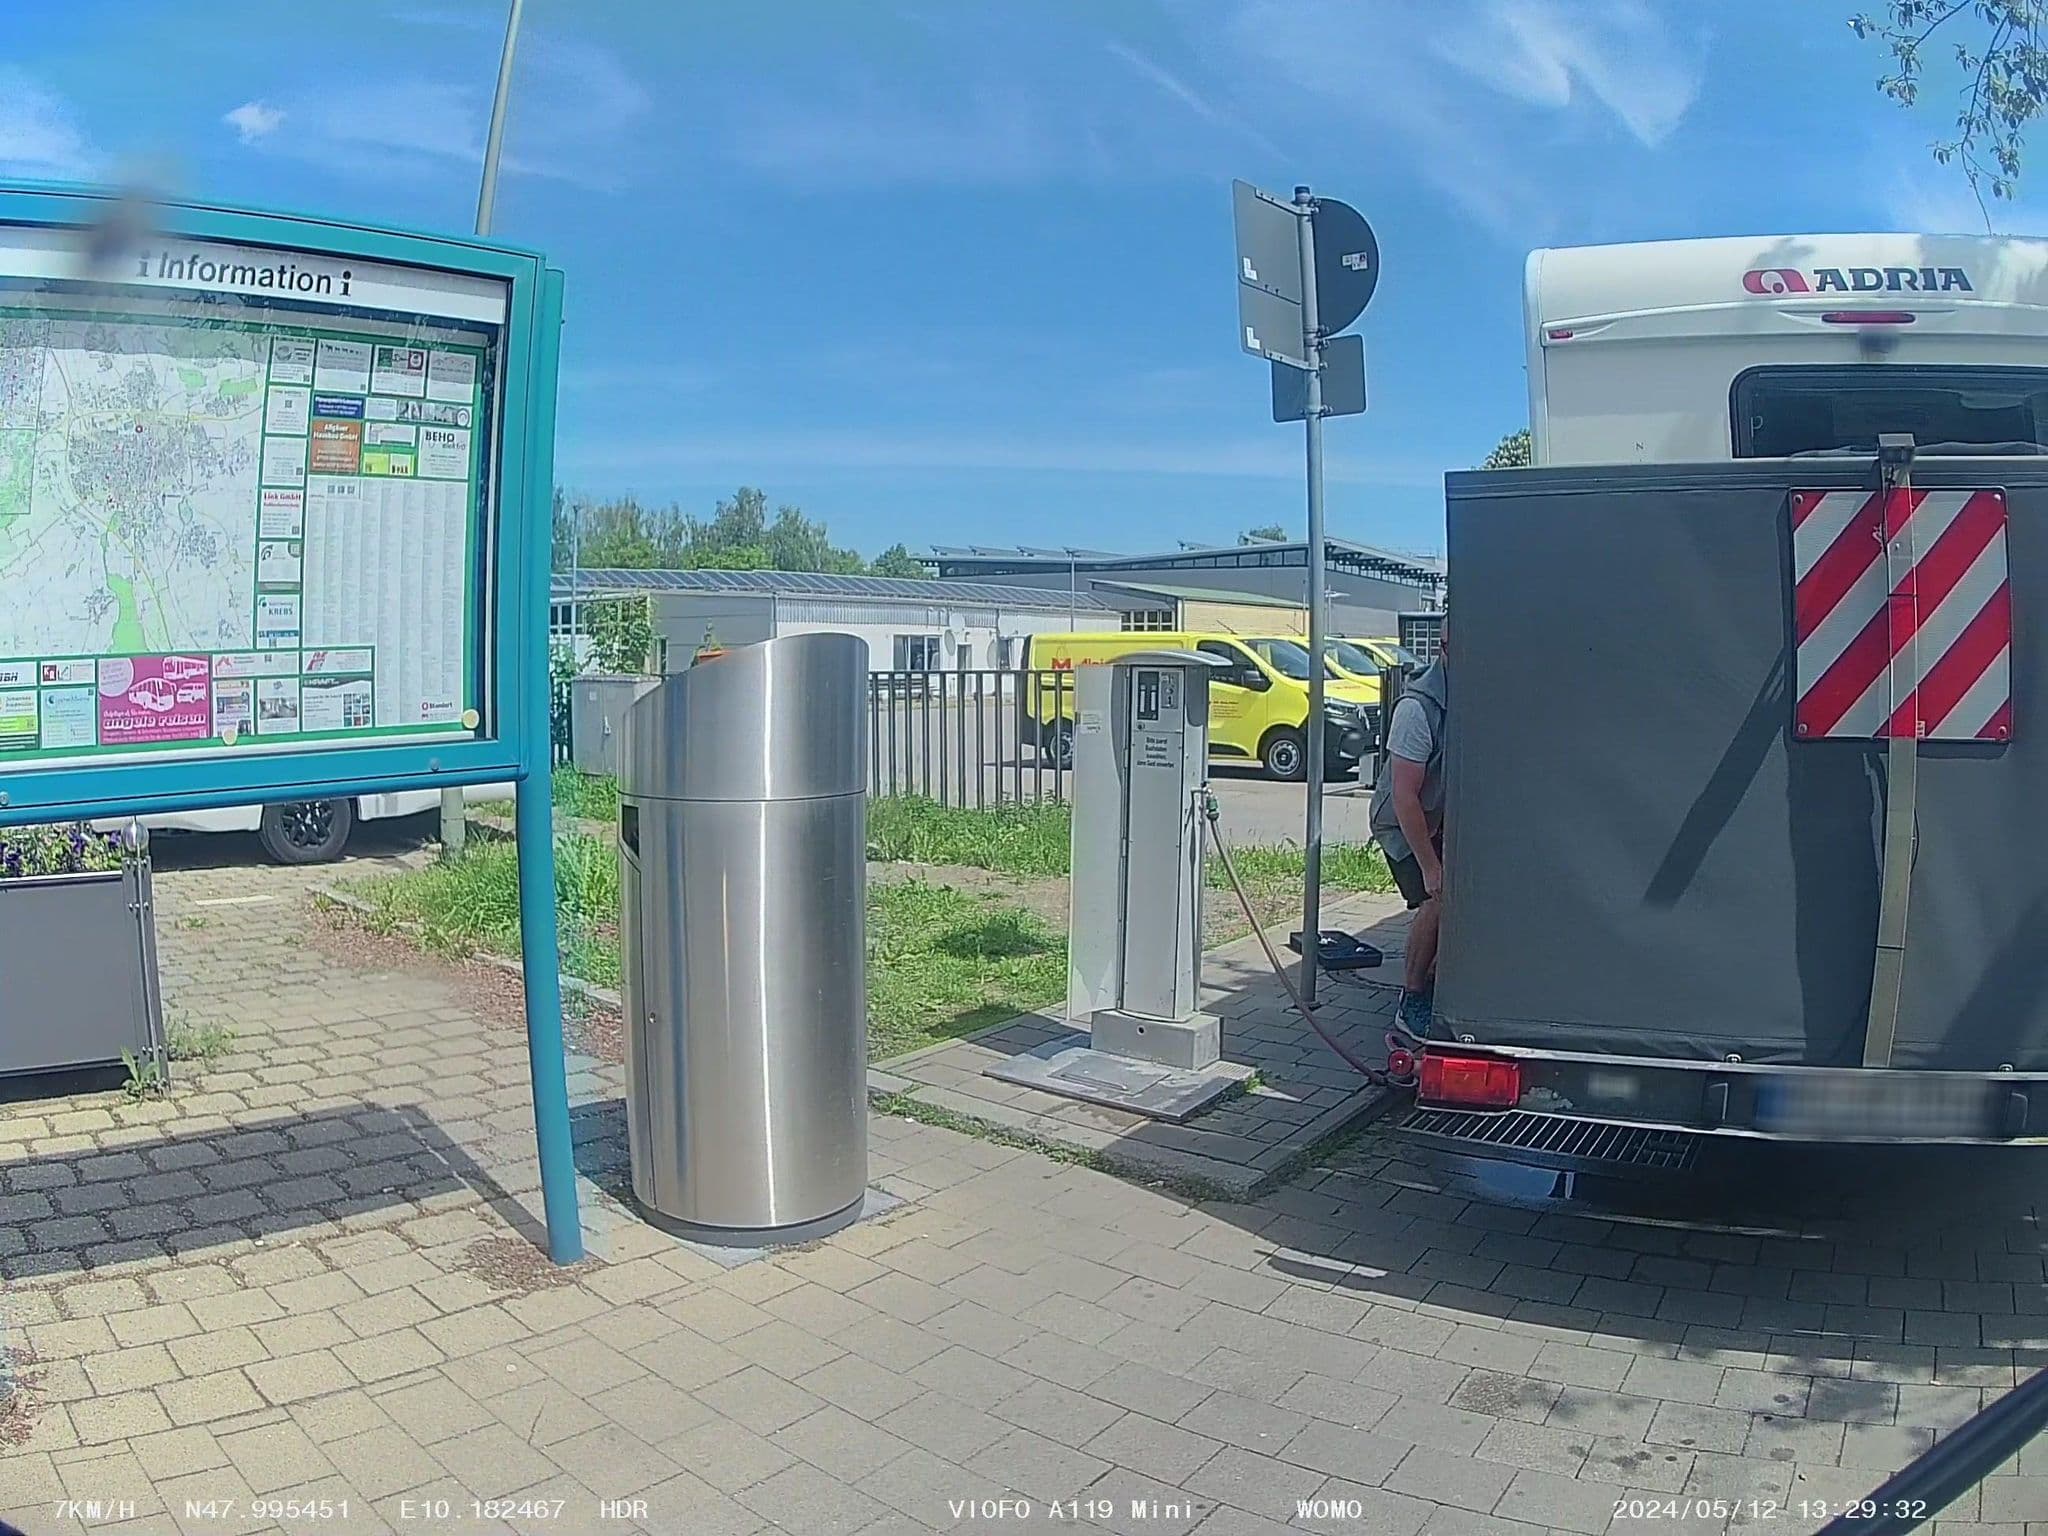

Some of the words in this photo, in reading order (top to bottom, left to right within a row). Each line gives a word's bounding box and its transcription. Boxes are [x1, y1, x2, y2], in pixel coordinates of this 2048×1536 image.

[158, 253, 332, 294] Information
[1813, 267, 1974, 292] ADRIA
[425, 431, 455, 443] BEHO
